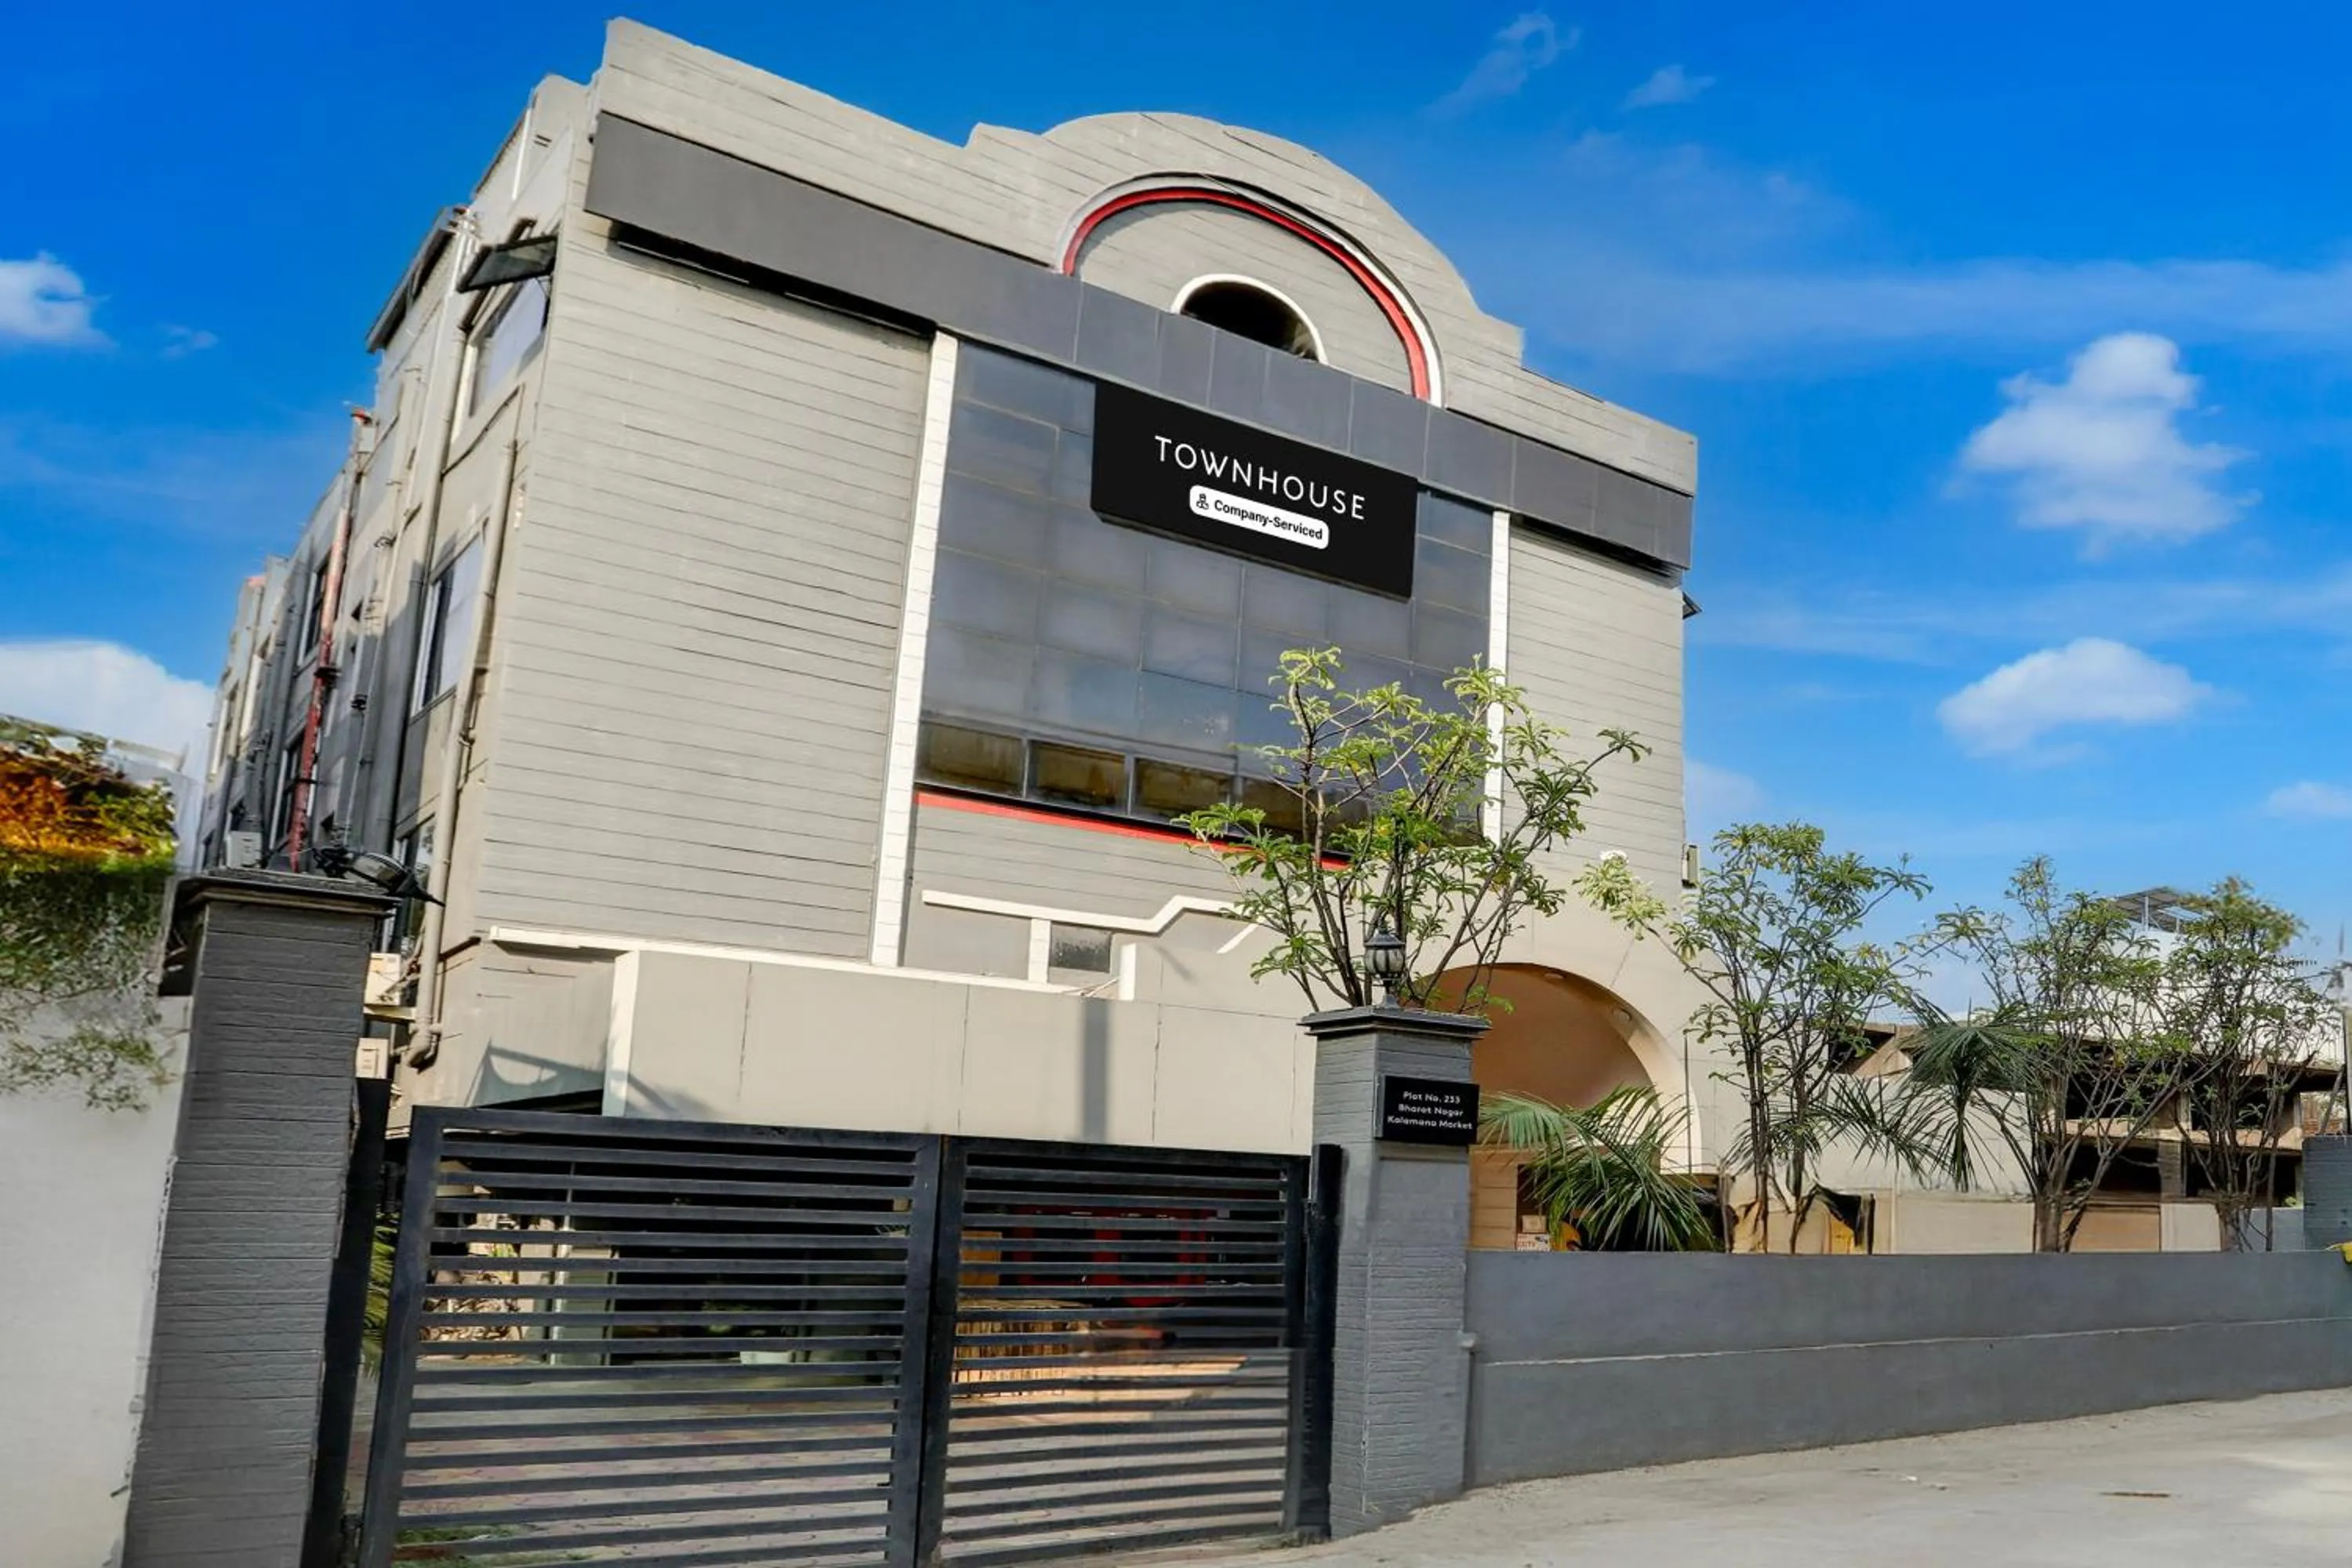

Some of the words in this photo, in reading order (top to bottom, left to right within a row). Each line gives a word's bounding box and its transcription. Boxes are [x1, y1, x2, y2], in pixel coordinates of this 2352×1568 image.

[1155, 435, 1366, 521] TOWNHOUSE
[1214, 499, 1323, 541] Company-Serviced
[1403, 1091, 1422, 1101] Plot
[1425, 1093, 1442, 1103] No.
[1398, 1103, 1432, 1114] Bharat
[1434, 1106, 1464, 1117] Nagar
[1439, 1120, 1473, 1130] Market
